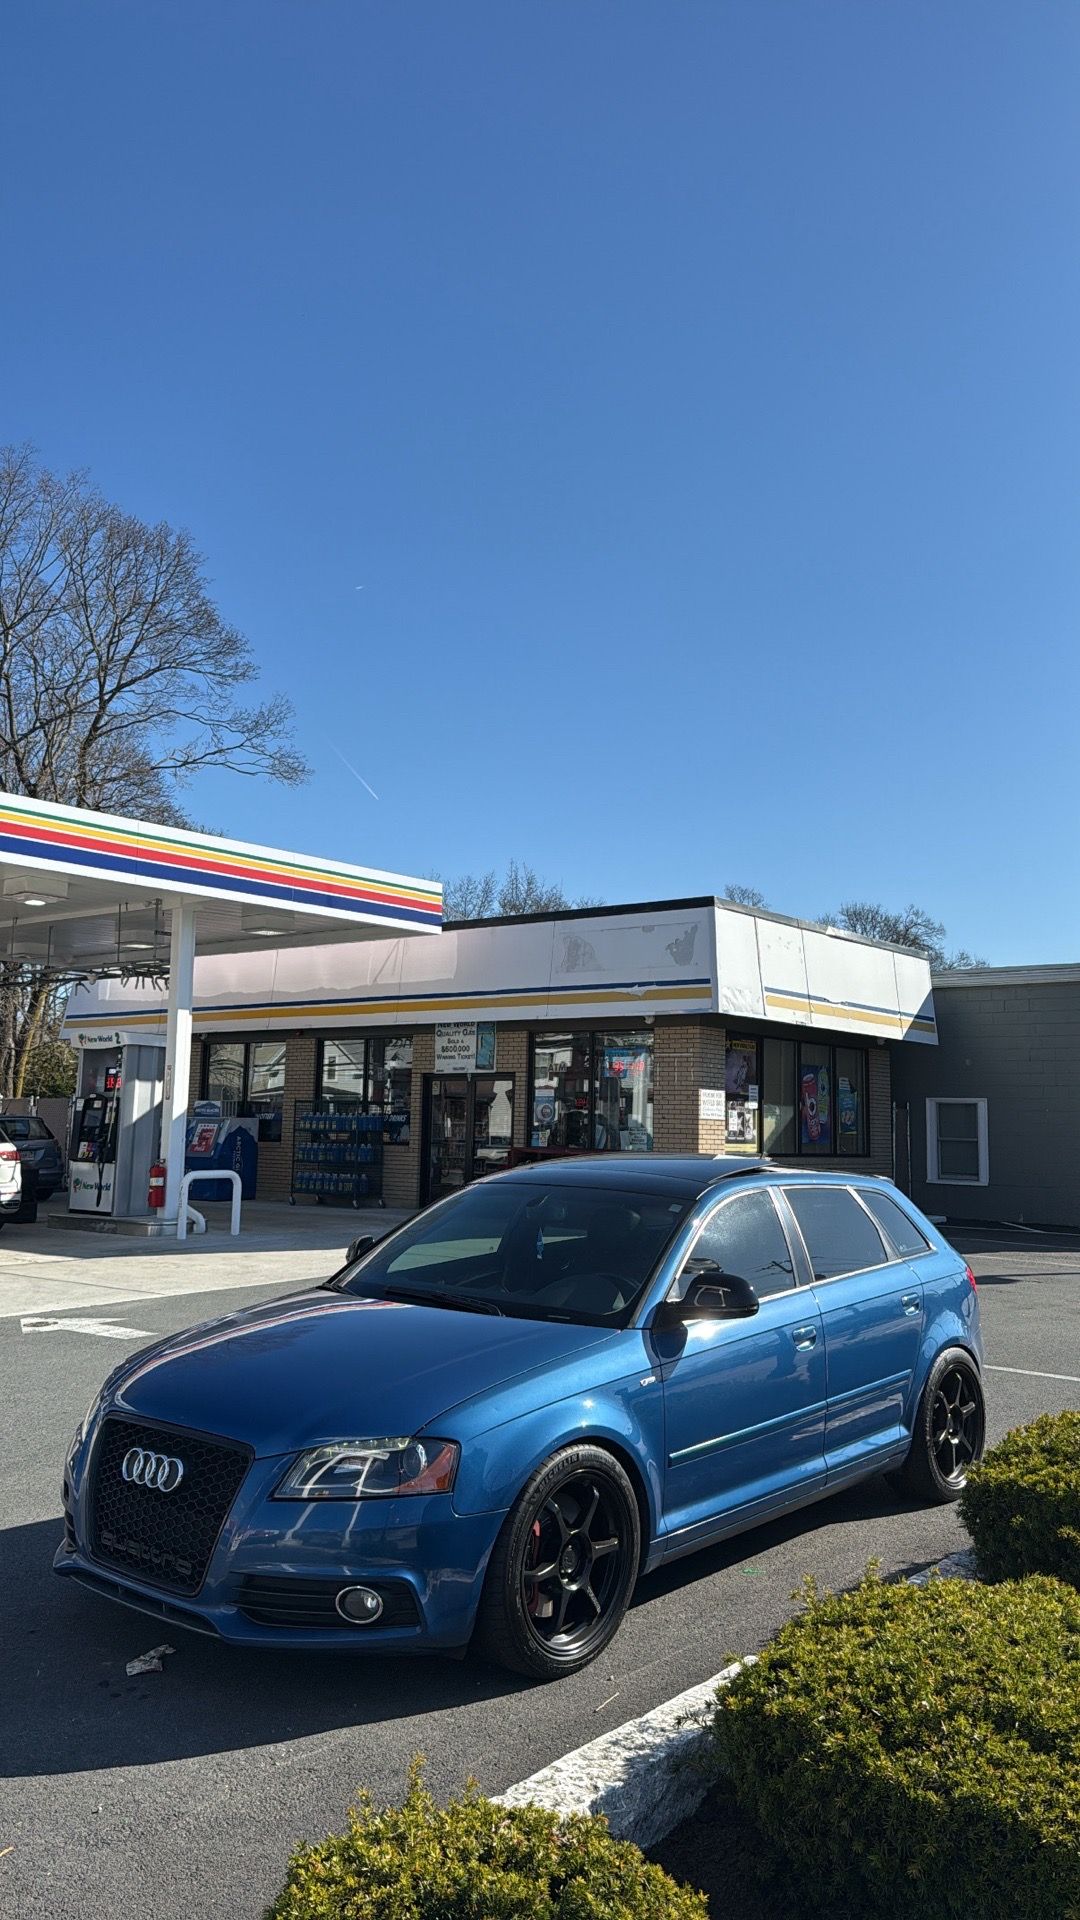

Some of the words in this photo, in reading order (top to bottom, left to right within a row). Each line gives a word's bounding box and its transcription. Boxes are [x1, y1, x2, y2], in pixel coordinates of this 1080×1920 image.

[115, 1032, 121, 1044] 2
[548, 1061, 567, 1072] ATM
[538, 1453, 579, 1492] MICHELIN
